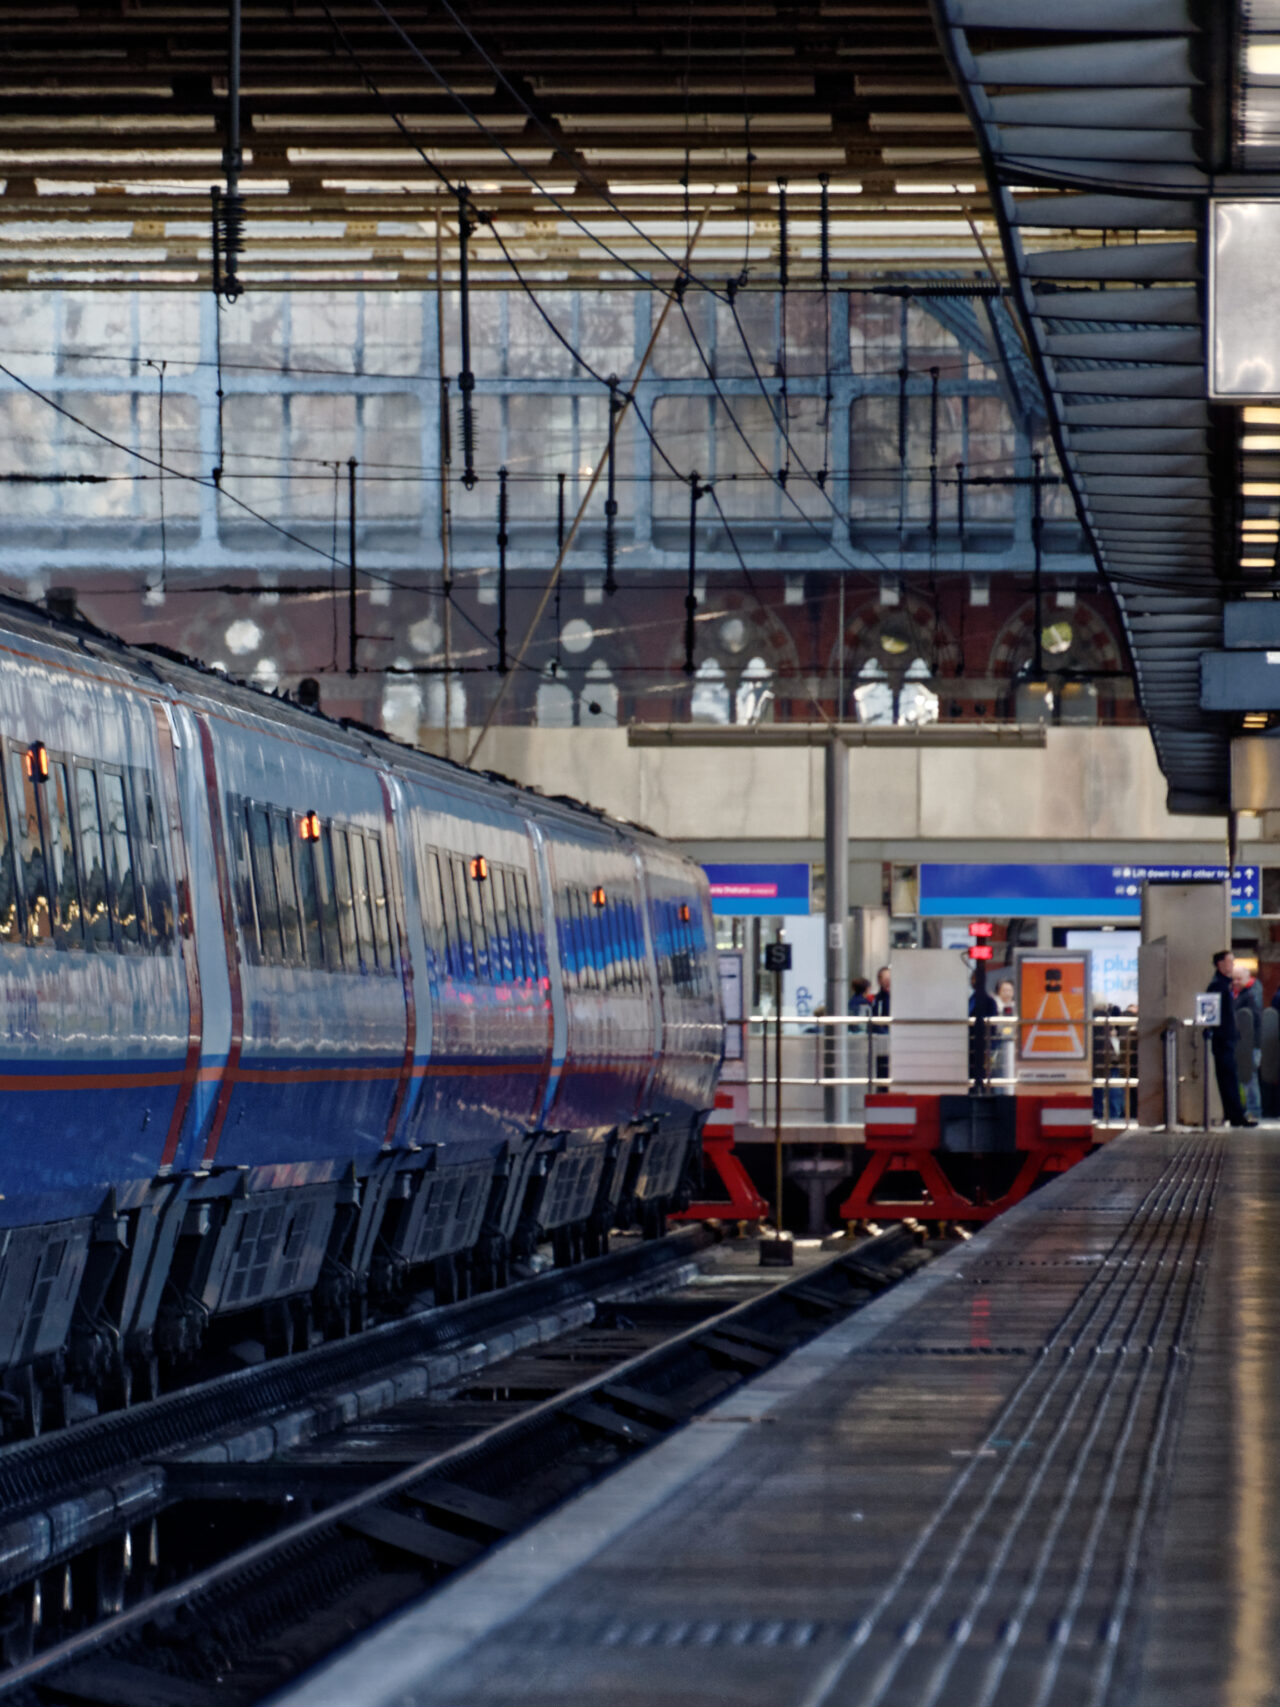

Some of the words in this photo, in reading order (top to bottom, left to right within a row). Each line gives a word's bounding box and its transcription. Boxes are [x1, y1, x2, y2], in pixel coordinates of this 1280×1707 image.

[1132, 868, 1147, 878] Lift
[1147, 868, 1170, 879] down
[1171, 869, 1180, 879] to
[1181, 868, 1192, 879] all
[1193, 868, 1215, 879] other
[772, 946, 787, 963] S
